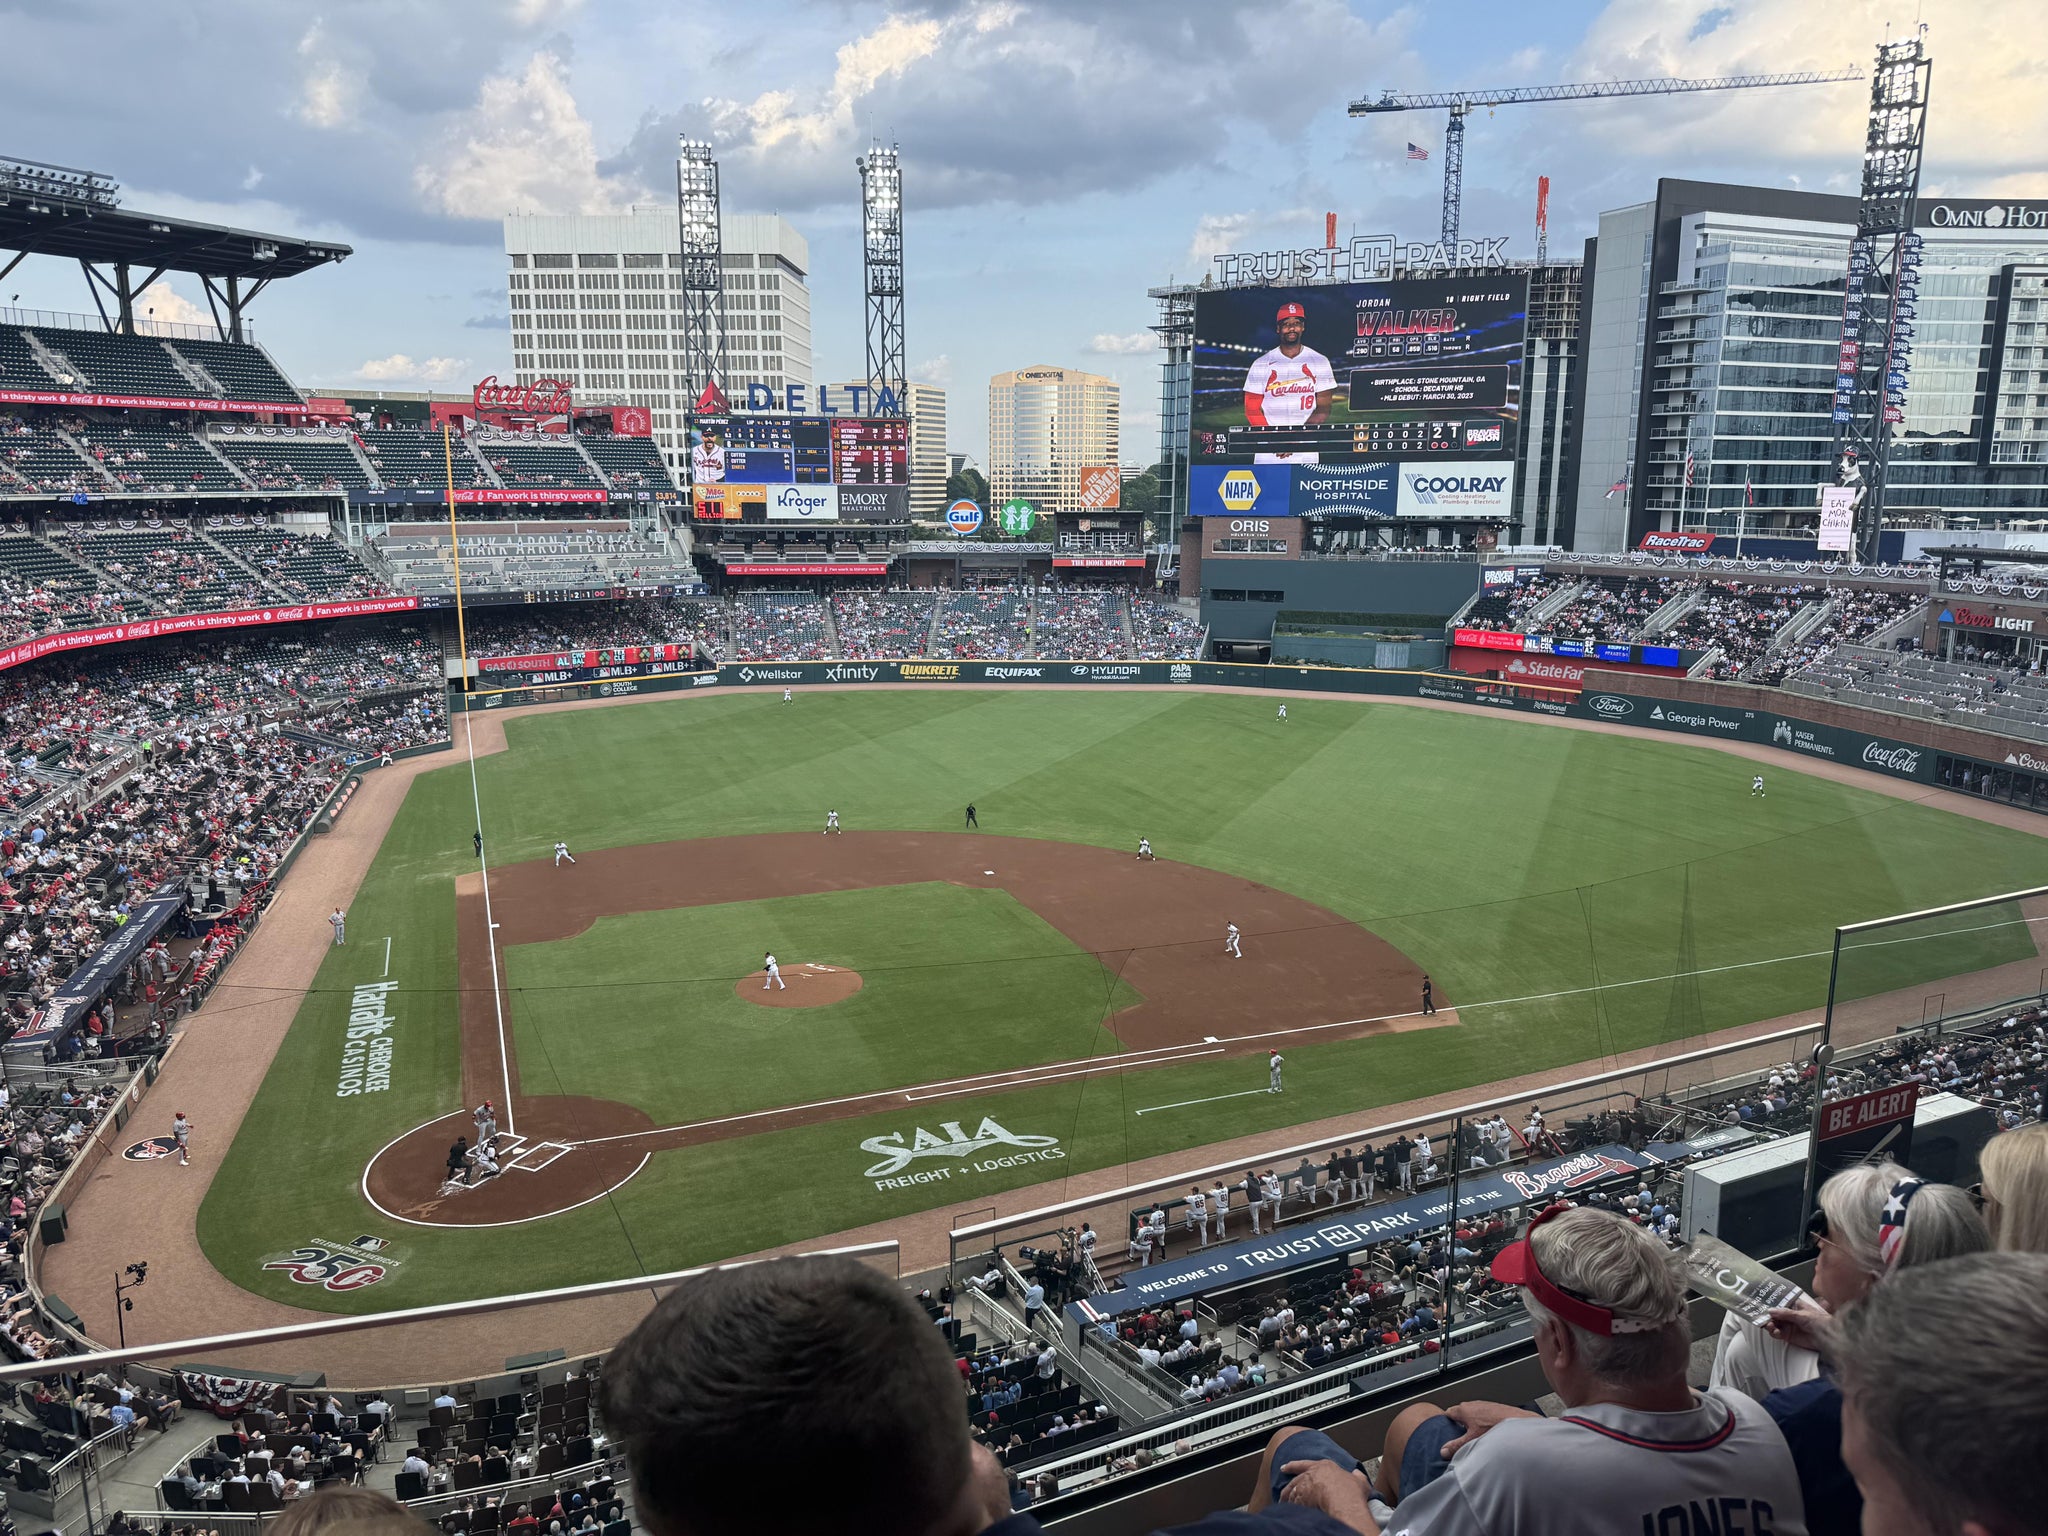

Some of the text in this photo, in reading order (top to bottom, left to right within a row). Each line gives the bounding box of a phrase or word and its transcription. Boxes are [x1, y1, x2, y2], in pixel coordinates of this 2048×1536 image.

[1930, 206, 1982, 226] OMNI
[1853, 242, 1866, 250] 1872
[1905, 237, 1919, 245] 1873
[1214, 237, 1509, 282] TRUIST PARK
[1851, 260, 1865, 268] 1874
[1903, 255, 1917, 263] 1875
[1850, 277, 1863, 285] 1877
[1901, 273, 1915, 281] 1878
[1356, 293, 1510, 308] JORDAN RIGHT FIELD
[1848, 294, 1862, 302] 1883
[1899, 290, 1913, 299] 1891
[1846, 311, 1860, 319] 1892
[1897, 307, 1911, 316] 1893
[1357, 308, 1456, 336] WALKER
[1844, 328, 1858, 336] 1897
[1895, 325, 1910, 333] 1898
[1842, 345, 1855, 353] 1914
[1893, 342, 1907, 351] 1948
[1840, 362, 1854, 370] 1957
[1891, 359, 1905, 368] 1958
[1025, 371, 1063, 379] ONEDIGITAL
[1374, 378, 1416, 386] BIRTHPLACE:
[1439, 376, 1475, 384] MOUNTAIN,
[1889, 377, 1904, 385] 1982
[473, 375, 575, 413] Coca-Cola
[1272, 382, 1315, 397] Cardinals
[748, 383, 899, 414] DELTA
[1301, 395, 1314, 410] 18
[1837, 396, 1850, 404] 1991
[1887, 394, 1901, 402] 1992
[1835, 412, 1849, 420] 1993
[1885, 412, 1900, 420] 1995
[1084, 471, 1101, 487] THE
[1300, 479, 1388, 490] NORTHSIDE
[1413, 476, 1508, 493] COOLRAY
[1081, 465, 1120, 507] HOME
[1224, 480, 1254, 500] NAPA
[539, 492, 569, 501] thirsty
[841, 494, 888, 505] EMORY
[1095, 482, 1119, 507] DEPOT
[1315, 492, 1371, 500] HOSPITAL
[777, 488, 827, 516] Kroger
[1831, 500, 1846, 508] EAT
[949, 511, 979, 523] Gulf
[1828, 509, 1847, 517] MOR
[1230, 520, 1269, 532] ORIS
[1823, 519, 1849, 528] CHIKIN
[1644, 535, 1705, 549] RaceTrac
[59, 600, 405, 647] is thirsty work work thirsty work
[1955, 608, 2035, 632] Coors LIGHT
[1526, 639, 1538, 649] NL
[1585, 640, 1593, 648] SF
[556, 652, 586, 666] AL CWS
[485, 659, 550, 672] GAS SOUTH
[611, 666, 637, 677] MLB+
[663, 662, 689, 672] MLB+
[900, 664, 960, 676] QUIKRETE
[1092, 666, 1140, 674] HYUNDAI
[1170, 664, 1192, 672] PAPA
[545, 671, 573, 682] MLB+
[756, 669, 802, 680] Wellstar
[826, 664, 879, 681] xfinity
[985, 667, 1043, 679] EQUIFAX
[1528, 663, 1583, 681] State Far
[1541, 703, 1567, 712] National
[1598, 698, 1626, 713] Ford
[1667, 711, 1740, 731] Georgia Power
[1795, 730, 1815, 742] KAISER
[1794, 739, 1833, 755] PERMANENTE
[1862, 740, 1922, 774] Coca-Cola
[346, 980, 399, 1039] Harrah's
[336, 1039, 367, 1098] CASINOS
[365, 1036, 394, 1094] CHEROKEE
[1829, 1090, 1911, 1132] BE ALERT
[860, 1116, 1059, 1177] SAIA
[875, 1148, 1066, 1192] FREIGHT LOGISTICS
[1502, 1153, 1599, 1200] Braves
[1137, 1190, 1502, 1294] WELCOME TO TRUIST PARK HOM OF THE
[311, 1238, 402, 1267] CELEBRATING AMERICA'S
[1715, 1269, 1749, 1295] 5
[1760, 1281, 1776, 1296] brings
[1766, 1284, 1787, 1304] Reliable
